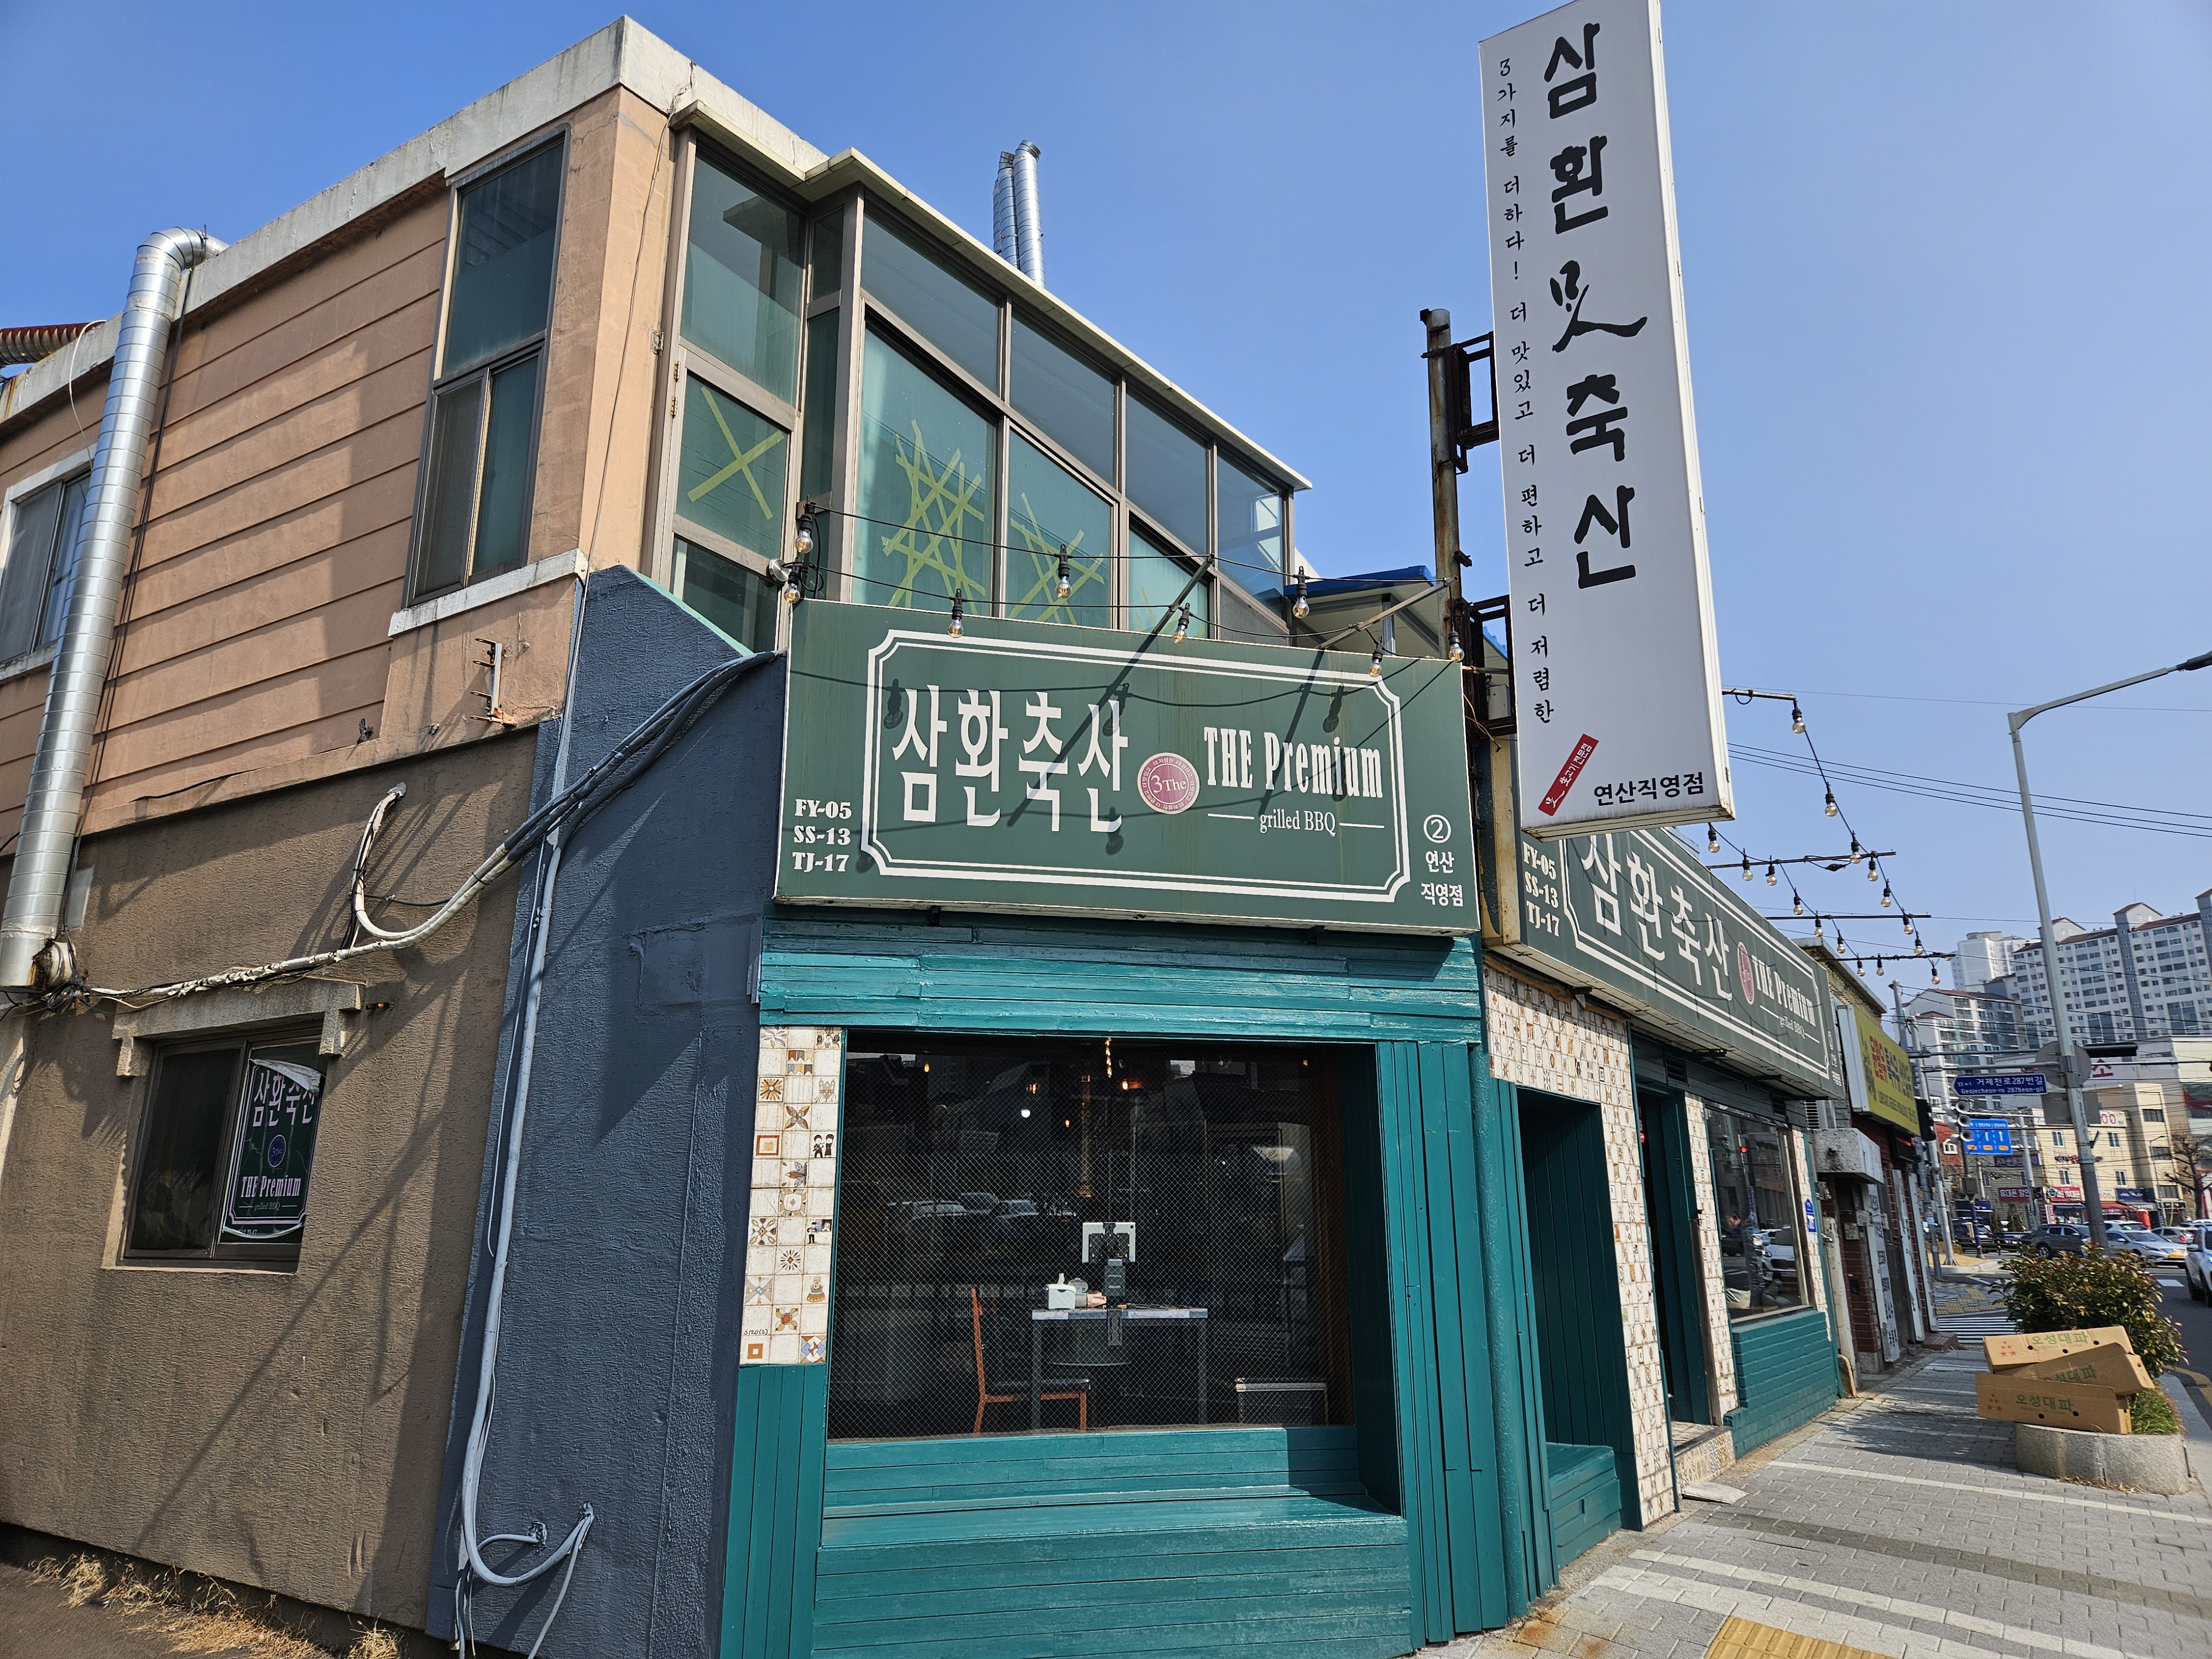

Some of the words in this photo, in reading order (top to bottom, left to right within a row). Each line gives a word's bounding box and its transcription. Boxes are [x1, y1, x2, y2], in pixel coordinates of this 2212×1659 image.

[1497, 59, 1517, 158] 3가지를
[1504, 175, 1525, 280] 더하다!
[1510, 302, 1527, 324] 더
[1511, 341, 1535, 420] 맛있고
[1518, 444, 1536, 466] 더
[1521, 484, 1544, 567] 편하고
[1527, 593, 1546, 616] 더
[1530, 635, 1554, 724] 저렴한
[891, 684, 1128, 833] 삼환축산
[1204, 727, 1253, 789] THE
[1264, 732, 1383, 798] Premium
[1573, 743, 1592, 765] 전문점
[1594, 771, 1704, 807] 연산직영점
[795, 799, 852, 820] FY-05
[794, 825, 851, 847] SS-13
[1260, 810, 1300, 833] grilled
[1304, 811, 1337, 837] BBQ
[792, 852, 849, 873] TJ-17
[1425, 850, 1454, 874] 연산
[1522, 841, 1557, 880] FY-05
[1421, 882, 1463, 907] 직영점
[1525, 871, 1558, 908] SS-13
[1526, 900, 1559, 937] TJ-17
[1580, 833, 1733, 1001] 삼환축산
[1751, 954, 1775, 1000] THE
[1774, 972, 1816, 1027] Premium
[1976, 1076, 2043, 1086] 거제천로287번길
[241, 1176, 258, 1198] THE
[259, 1175, 301, 1197] Premium
[2032, 1331, 2088, 1344] 오성대파
[2016, 1394, 2073, 1412] 오성대파
